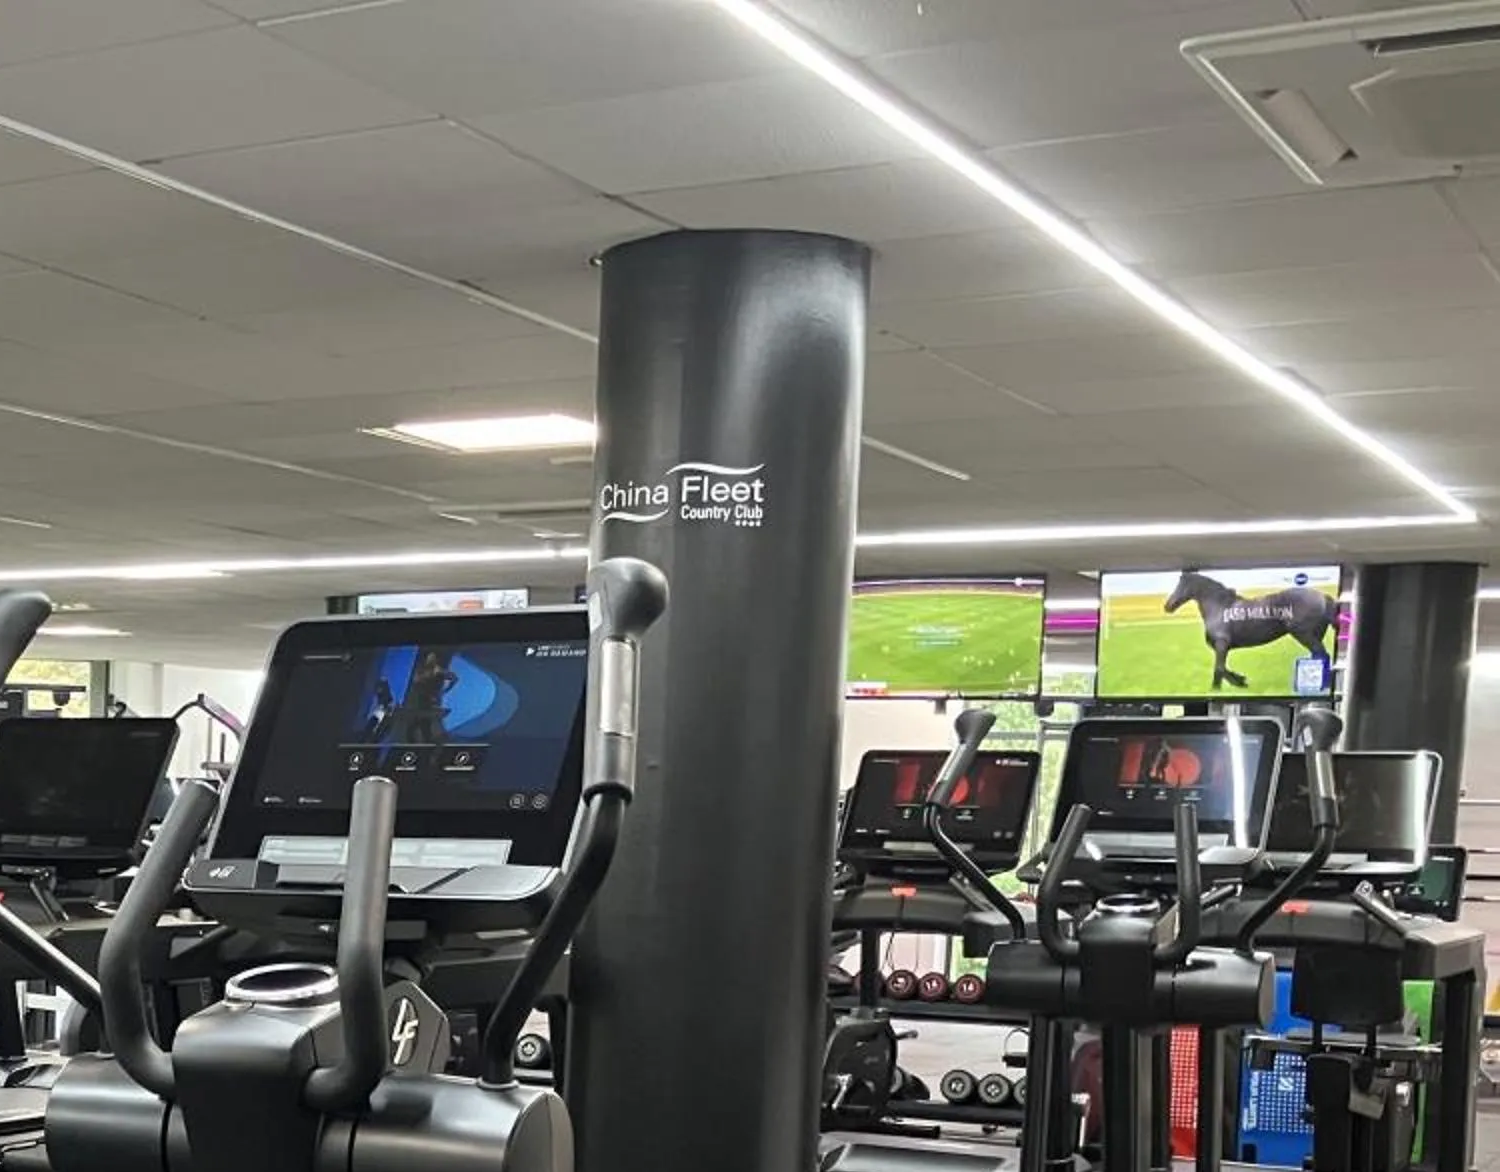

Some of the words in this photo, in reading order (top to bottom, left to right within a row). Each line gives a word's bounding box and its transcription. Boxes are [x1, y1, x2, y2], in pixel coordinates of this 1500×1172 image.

[600, 481, 669, 511] China
[681, 475, 765, 503] Fleet
[681, 504, 731, 522] Country
[735, 504, 763, 520] Club
